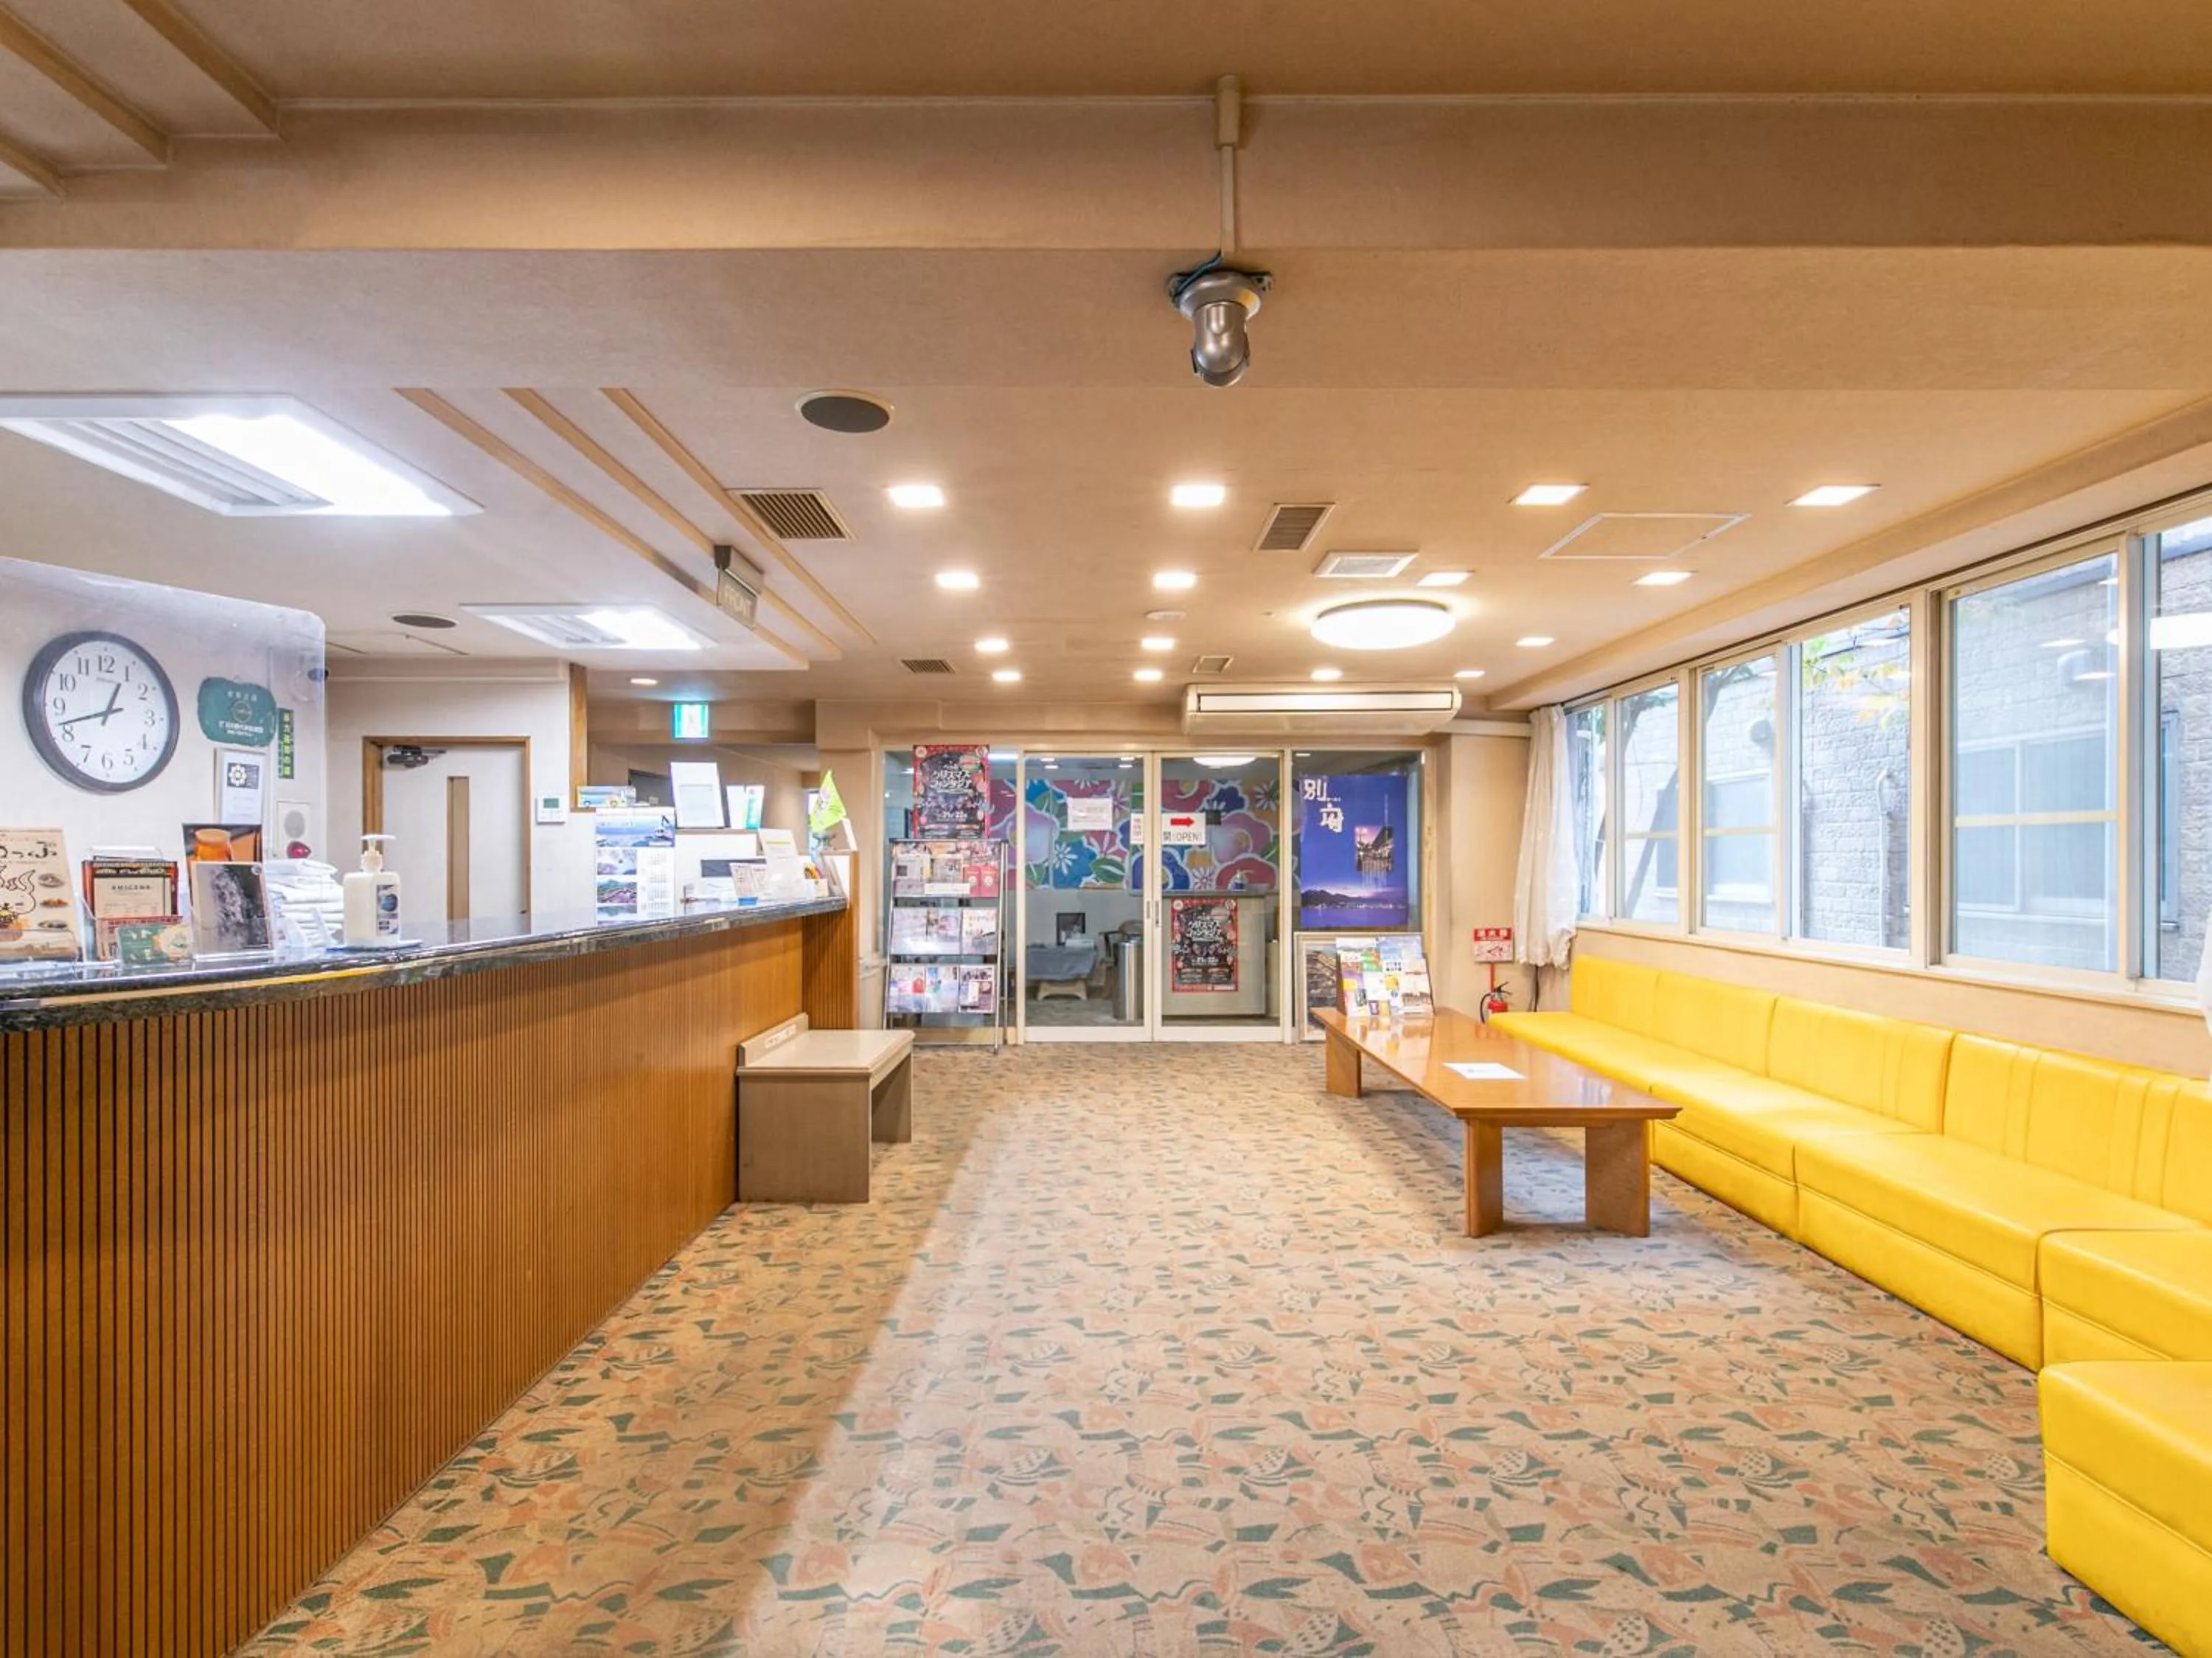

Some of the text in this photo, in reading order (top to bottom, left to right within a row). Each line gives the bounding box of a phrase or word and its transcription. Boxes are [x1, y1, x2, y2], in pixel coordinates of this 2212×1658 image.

[77, 656, 89, 676] 11
[97, 655, 115, 673] 12
[125, 665, 130, 681] 1
[60, 673, 76, 692] 10
[137, 683, 148, 700] 2
[52, 697, 66, 715] 9
[144, 710, 156, 726] 3
[62, 723, 74, 742] 8
[80, 744, 91, 763] 7
[101, 752, 114, 769] 6
[123, 747, 134, 765] 5
[932, 769, 970, 781] クリスマス
[1176, 831, 1199, 842] OPEN
